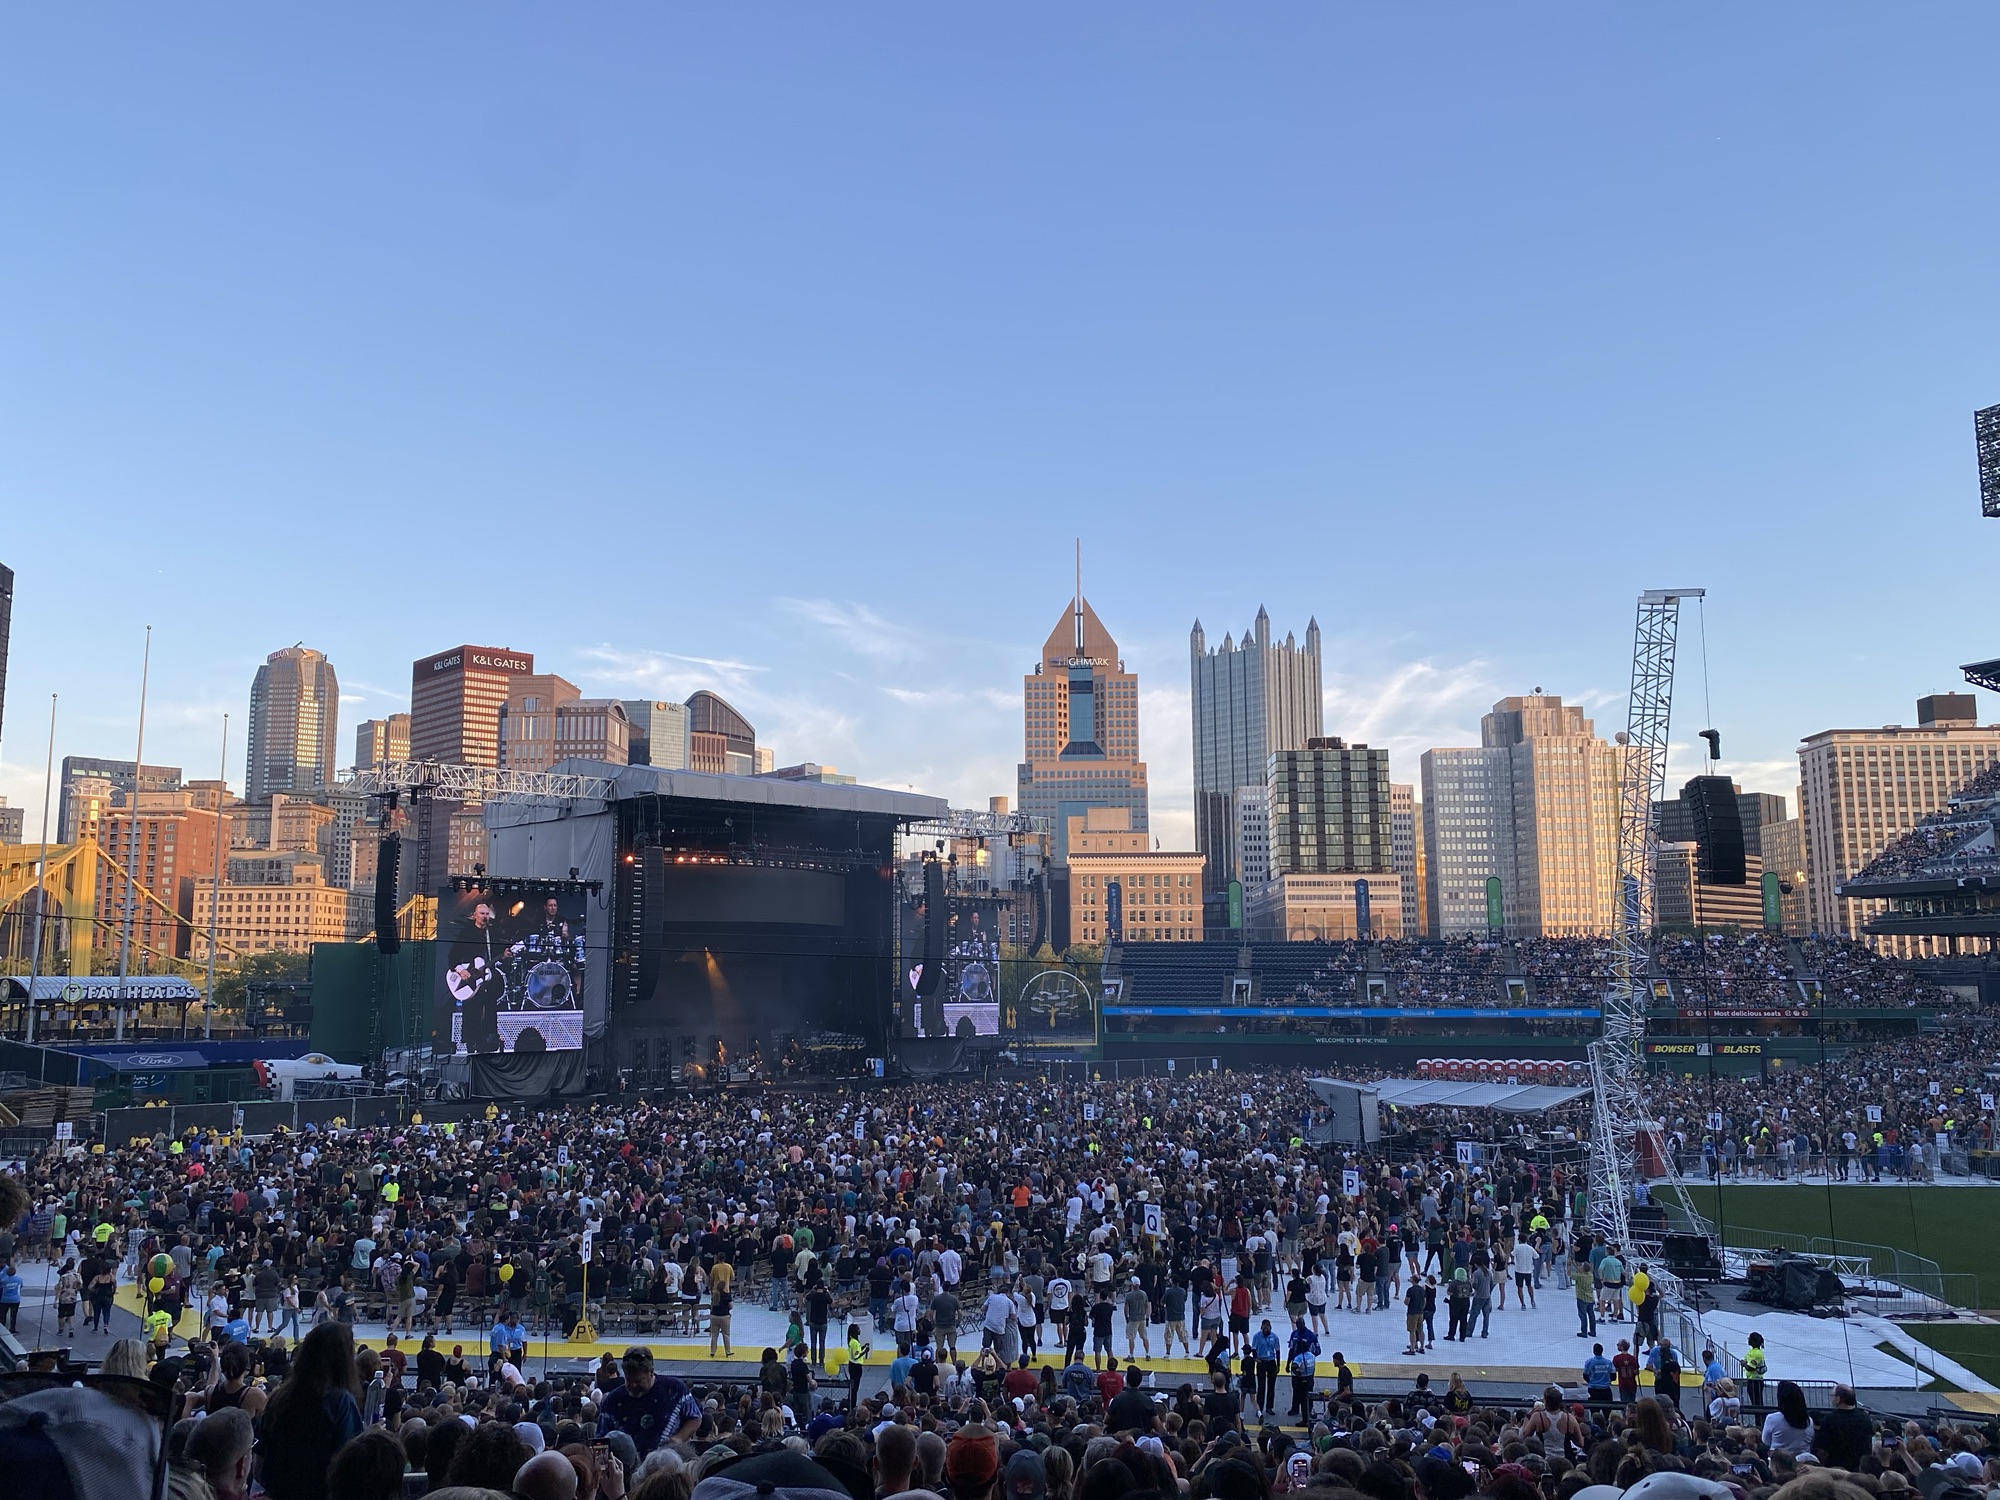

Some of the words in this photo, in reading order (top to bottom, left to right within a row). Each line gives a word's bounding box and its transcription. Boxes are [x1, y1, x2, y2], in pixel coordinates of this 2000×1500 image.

[434, 660, 444, 671] K&L
[443, 655, 461, 668] GATES
[473, 654, 492, 666] K&L
[493, 657, 527, 671] GATES
[1058, 657, 1109, 667] HIGHMARK
[87, 986, 121, 999] FAT
[126, 986, 195, 999] HEAD'S
[1654, 1045, 1695, 1053] BOWSER
[1723, 1045, 1761, 1054] BLASTS
[138, 1055, 174, 1065] Ford
[1932, 1086, 1937, 1094] J
[1243, 1097, 1249, 1107] D
[1983, 1098, 1992, 1108] K
[1086, 1109, 1092, 1118] E
[1871, 1110, 1879, 1120] L
[1710, 1118, 1720, 1129] M
[856, 1126, 861, 1137] F
[558, 1152, 566, 1165] G
[1459, 1148, 1468, 1161] N
[1346, 1178, 1354, 1192] P
[1147, 1214, 1158, 1232] Q
[584, 1240, 590, 1260] R
[576, 1325, 586, 1339] P
[588, 1324, 594, 1338] P
